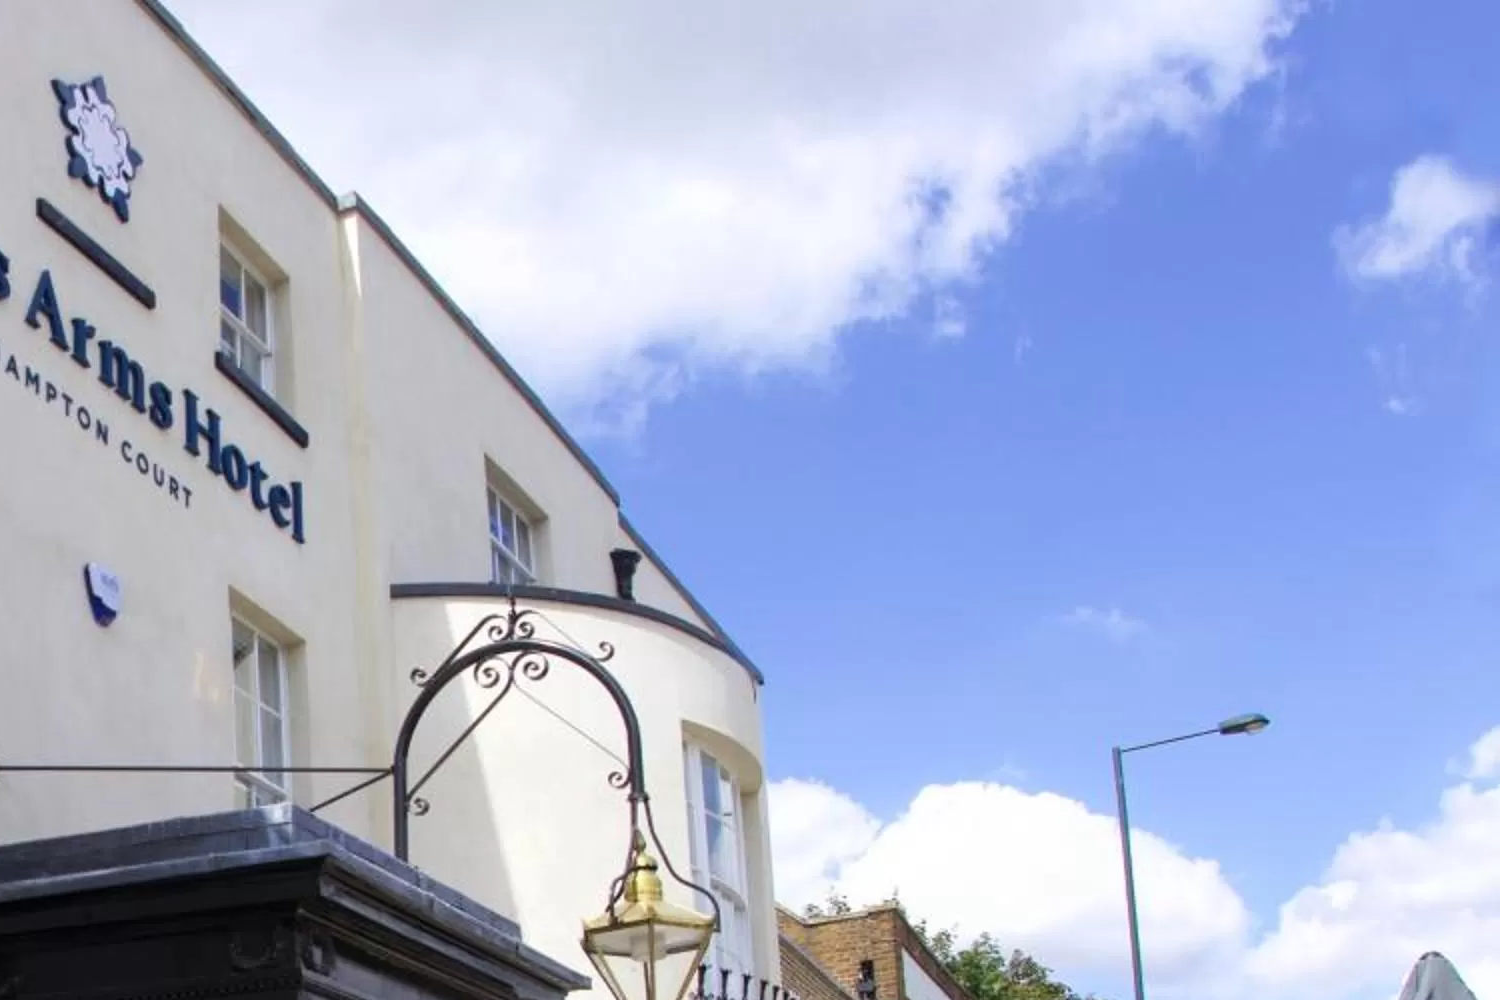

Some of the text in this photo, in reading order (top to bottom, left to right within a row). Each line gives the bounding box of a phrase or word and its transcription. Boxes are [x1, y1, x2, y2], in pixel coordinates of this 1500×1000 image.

[25, 269, 173, 431] Arms
[183, 388, 305, 545] Hotel
[121, 441, 193, 509] COURT
